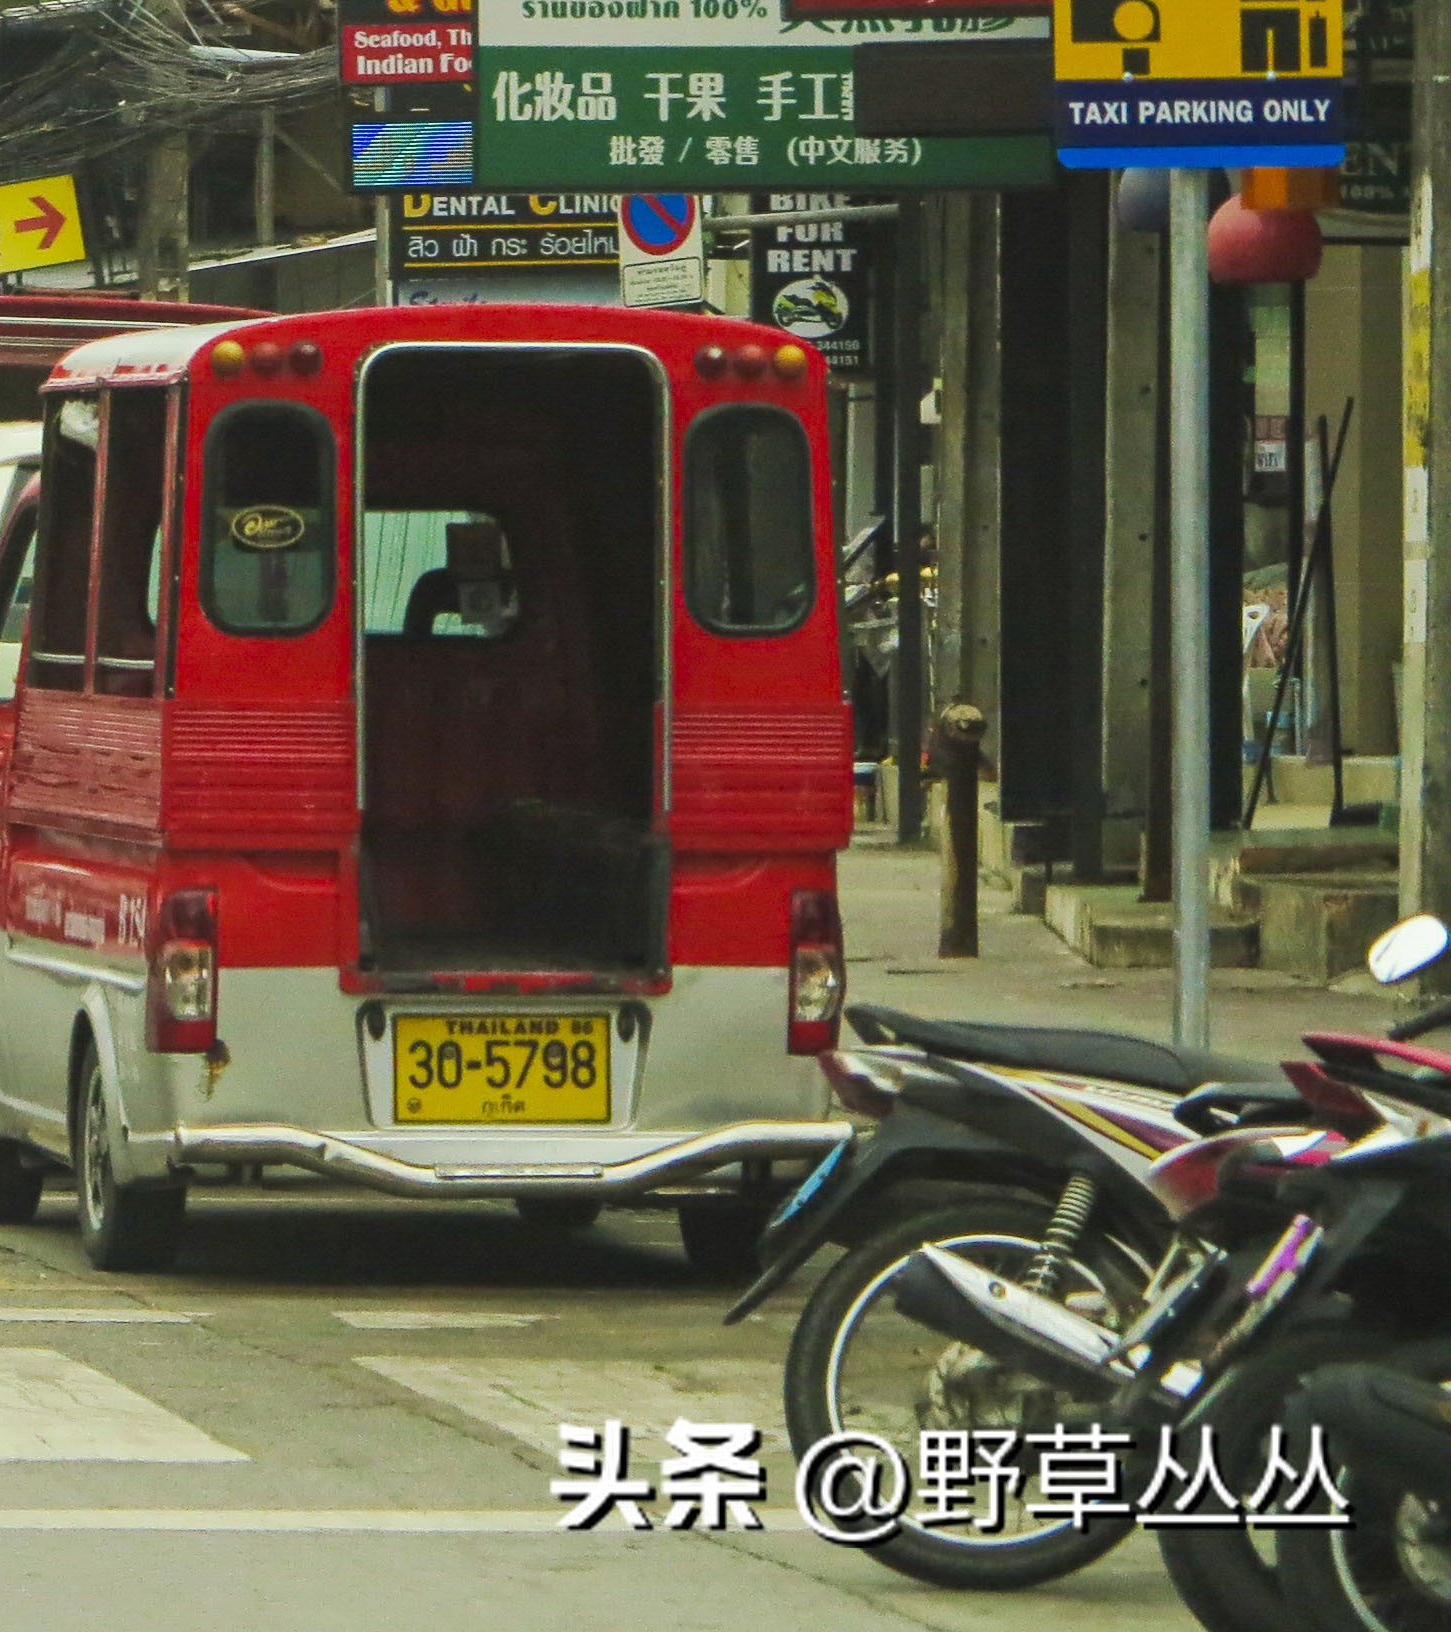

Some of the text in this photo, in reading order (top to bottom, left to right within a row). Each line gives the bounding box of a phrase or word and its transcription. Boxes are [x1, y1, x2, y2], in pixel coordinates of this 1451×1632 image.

[353, 29, 442, 49] Seafood,
[356, 52, 472, 75] Indian Fo
[644, 71, 728, 124] 干果
[1069, 98, 1332, 125] TAXI PARKING ONLY
[609, 136, 666, 167] 批發
[704, 135, 760, 166] 零售
[403, 194, 516, 218] DENTAL
[770, 194, 852, 211] BIKE
[491, 235, 528, 256] กระ
[767, 248, 859, 273] RENT
[446, 1019, 560, 1035] THAILAND
[408, 1039, 598, 1089] 30-5798
